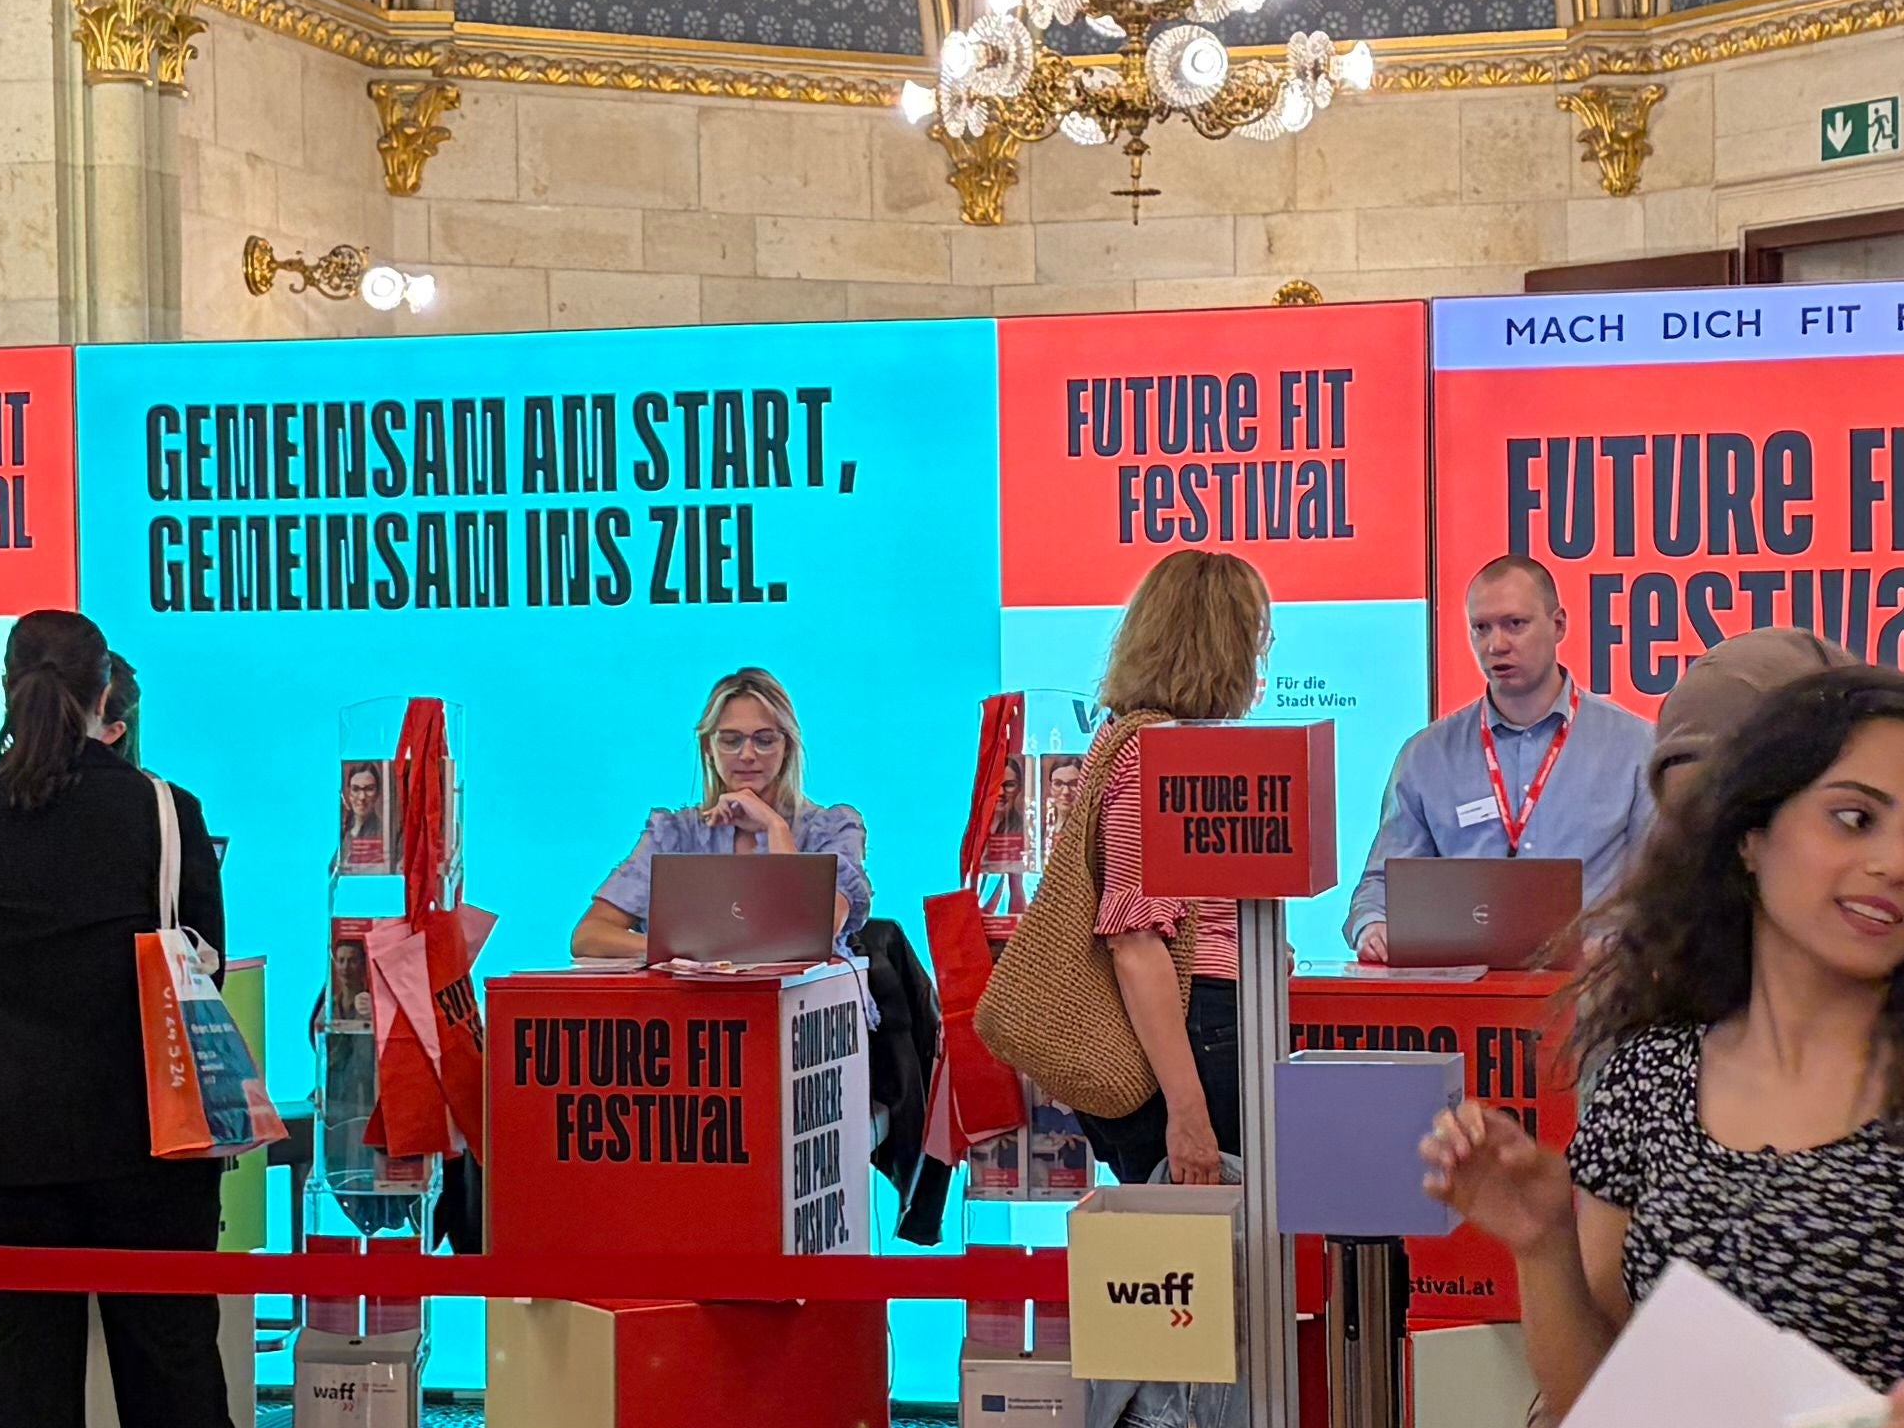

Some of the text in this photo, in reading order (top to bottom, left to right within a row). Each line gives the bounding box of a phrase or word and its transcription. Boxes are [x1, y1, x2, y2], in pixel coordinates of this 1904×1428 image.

[1506, 314, 1625, 346] MACH
[1662, 309, 1762, 340] DICH
[1800, 304, 1861, 335] FIT
[1280, 369, 1353, 452] FIT
[146, 386, 857, 501] GEMEINSAM AM START,
[149, 504, 788, 612] GEMEINSAM INS ZIEL.
[1276, 675, 1326, 690] Für die
[1276, 693, 1356, 708] Stadt Wien
[1257, 773, 1292, 814] FIT
[687, 1018, 748, 1089] FIT
[1477, 1026, 1542, 1099] FIT
[1107, 1272, 1194, 1306] waff
[313, 1382, 356, 1400] waff
